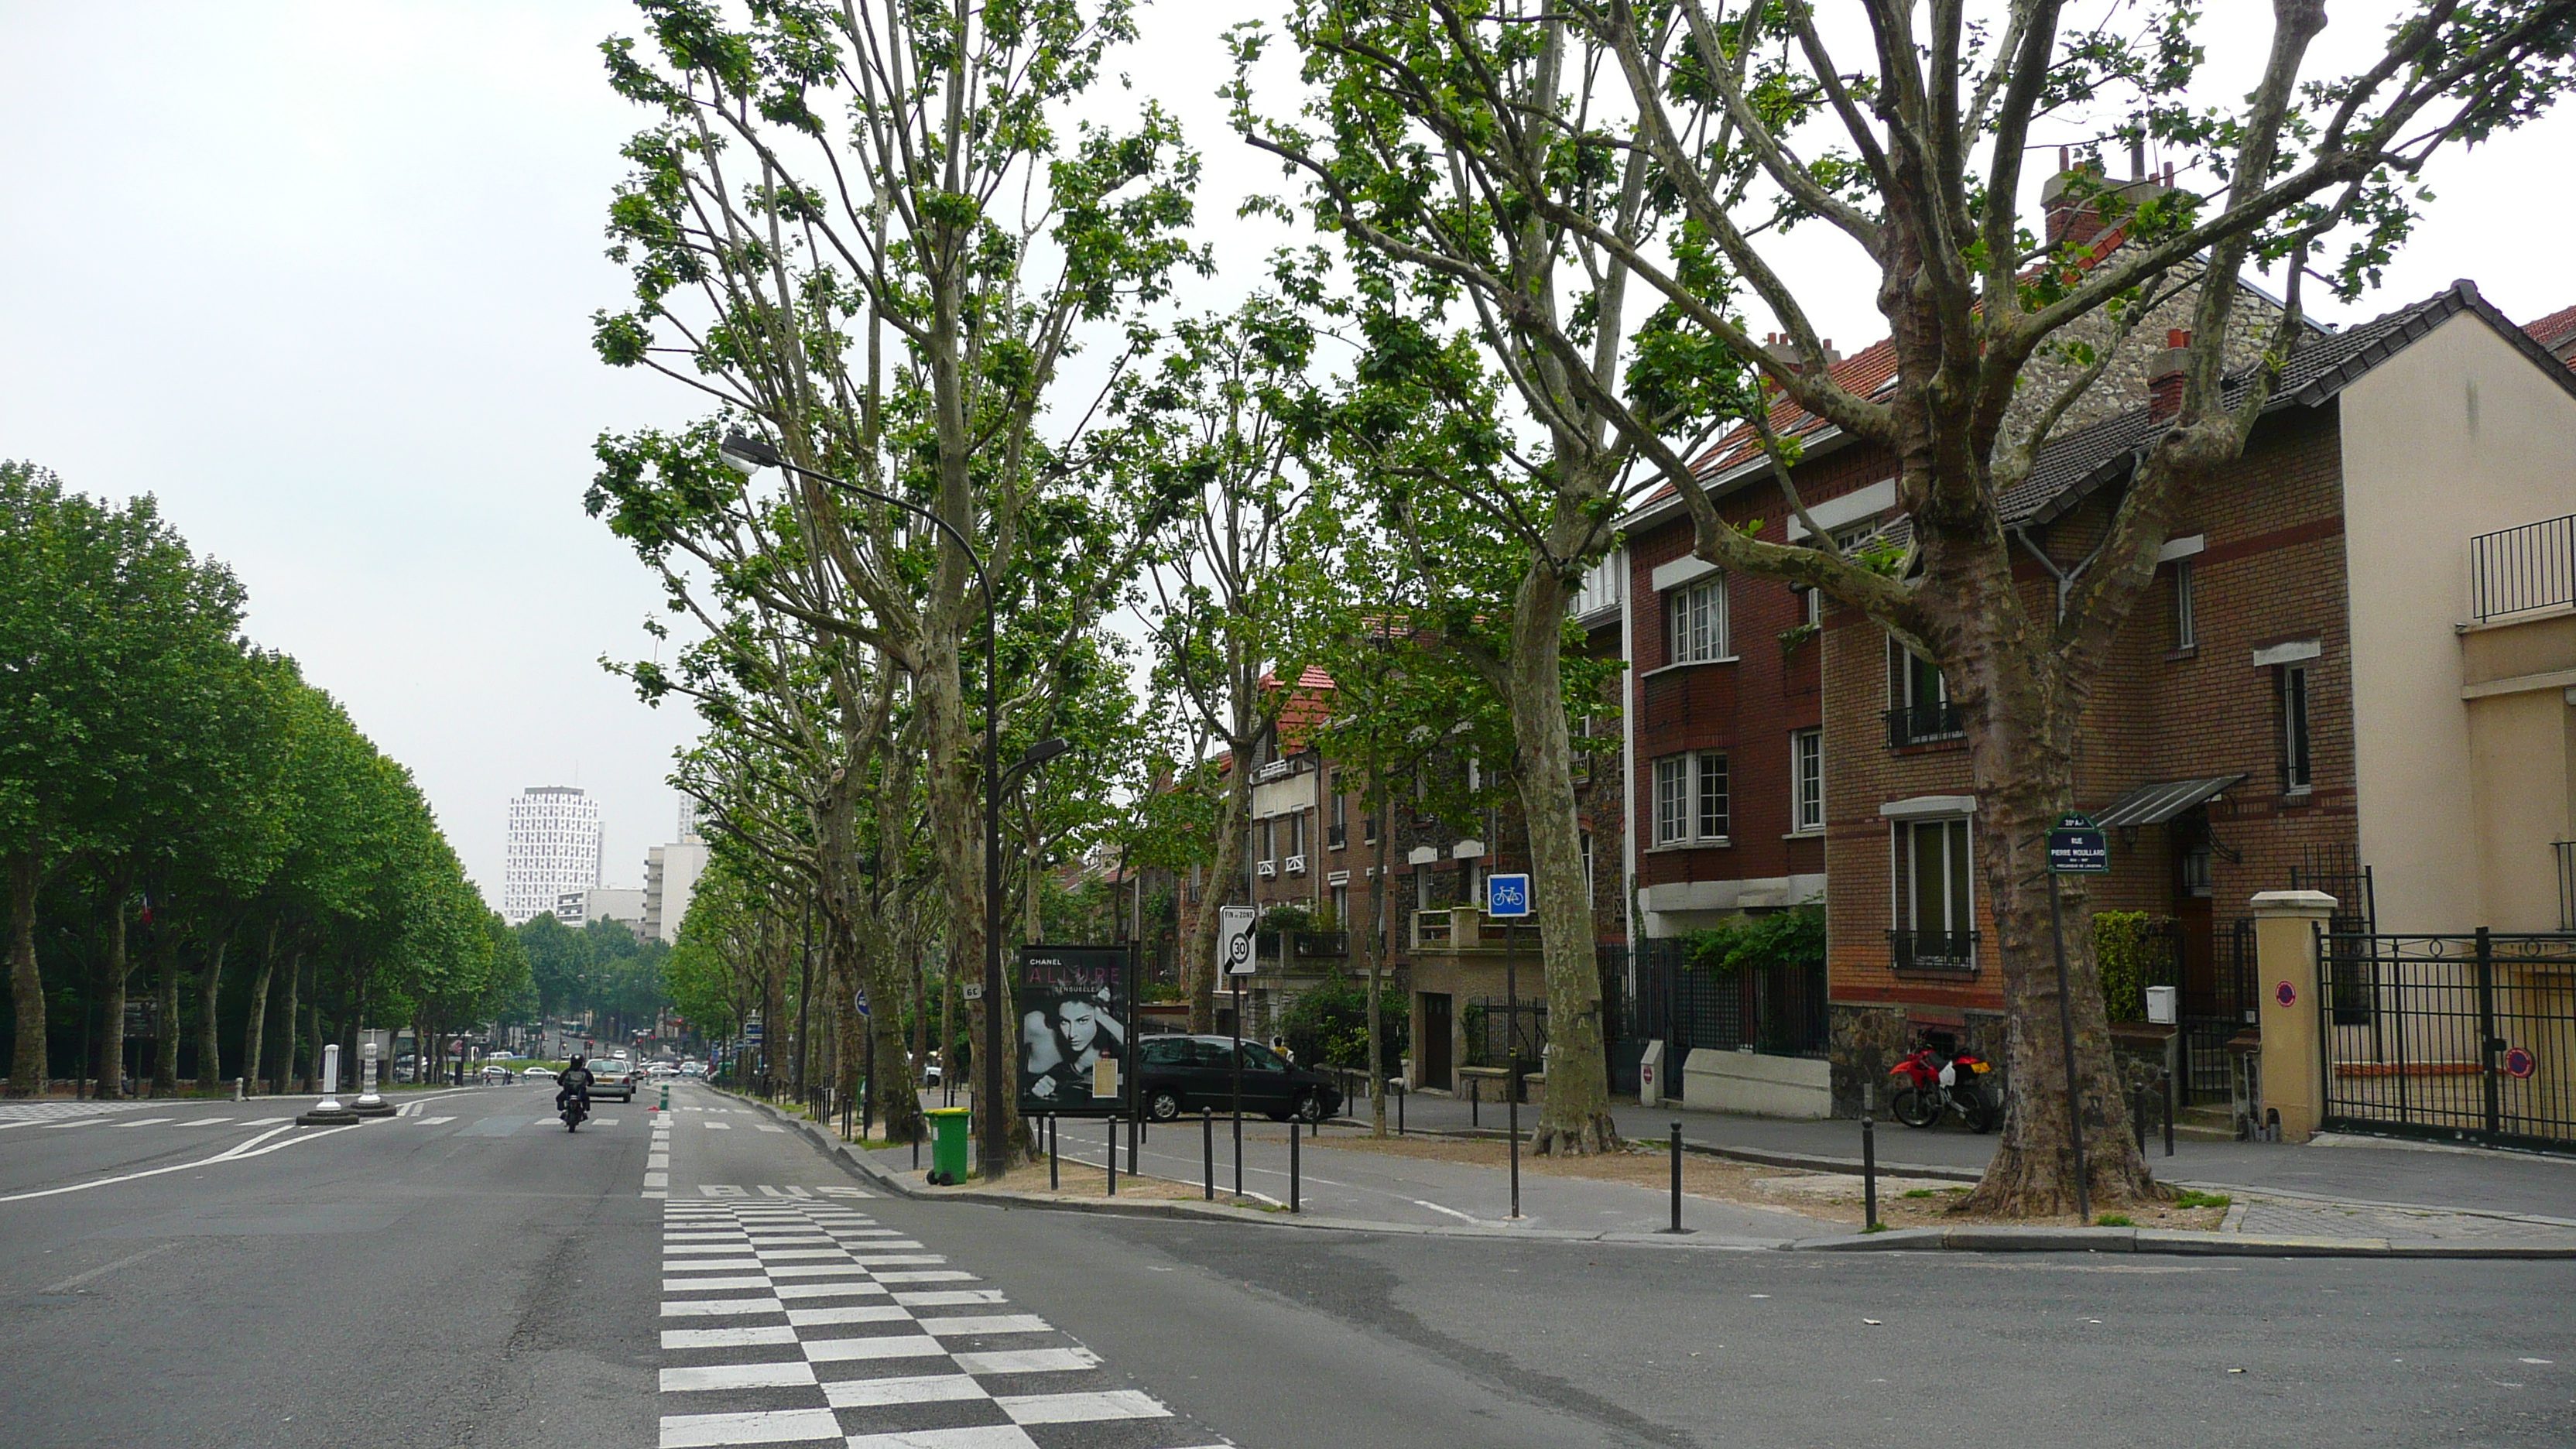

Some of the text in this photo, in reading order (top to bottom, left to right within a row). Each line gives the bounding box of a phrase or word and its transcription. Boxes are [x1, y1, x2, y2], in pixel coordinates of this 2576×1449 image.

[1234, 942, 1245, 955] 30
[1029, 967, 1121, 984] ALLURE
[698, 1185, 876, 1199] BUS
